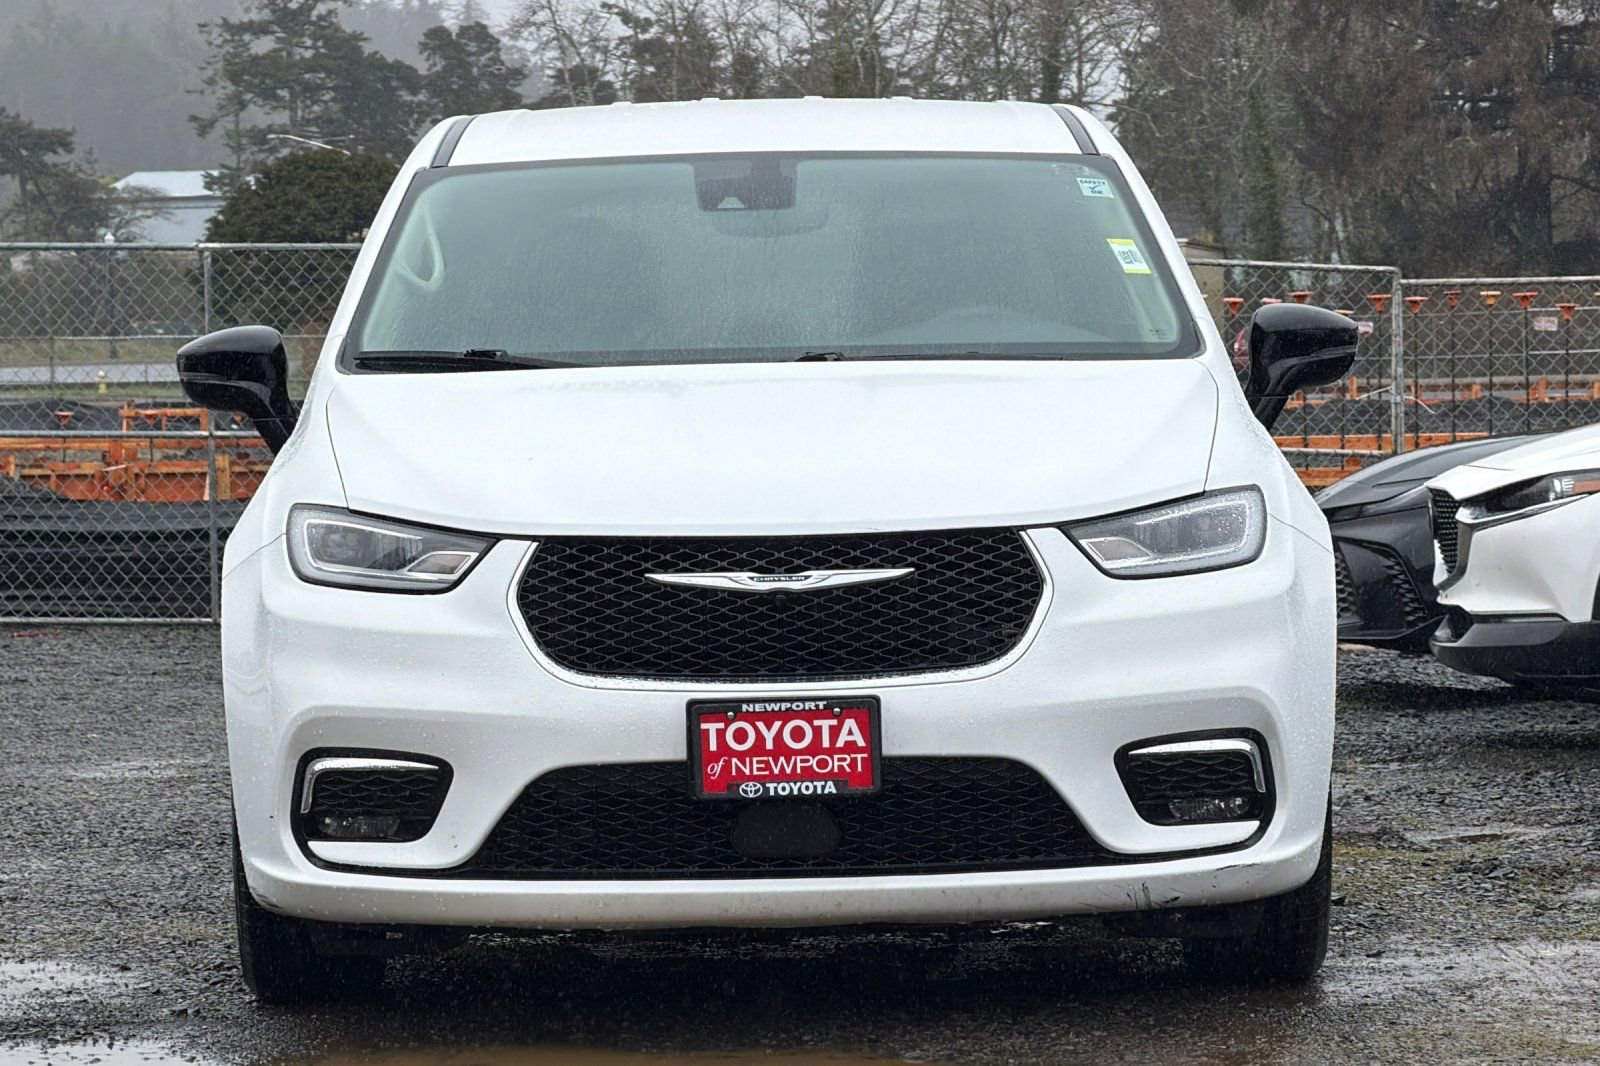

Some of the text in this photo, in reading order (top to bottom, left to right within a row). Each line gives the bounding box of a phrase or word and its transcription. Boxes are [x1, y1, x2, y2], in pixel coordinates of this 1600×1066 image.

[742, 702, 827, 712] NEWPORT
[701, 719, 866, 751] TOYOTA
[707, 754, 868, 779] of NEWPORT
[766, 781, 837, 796] TOYOTA
